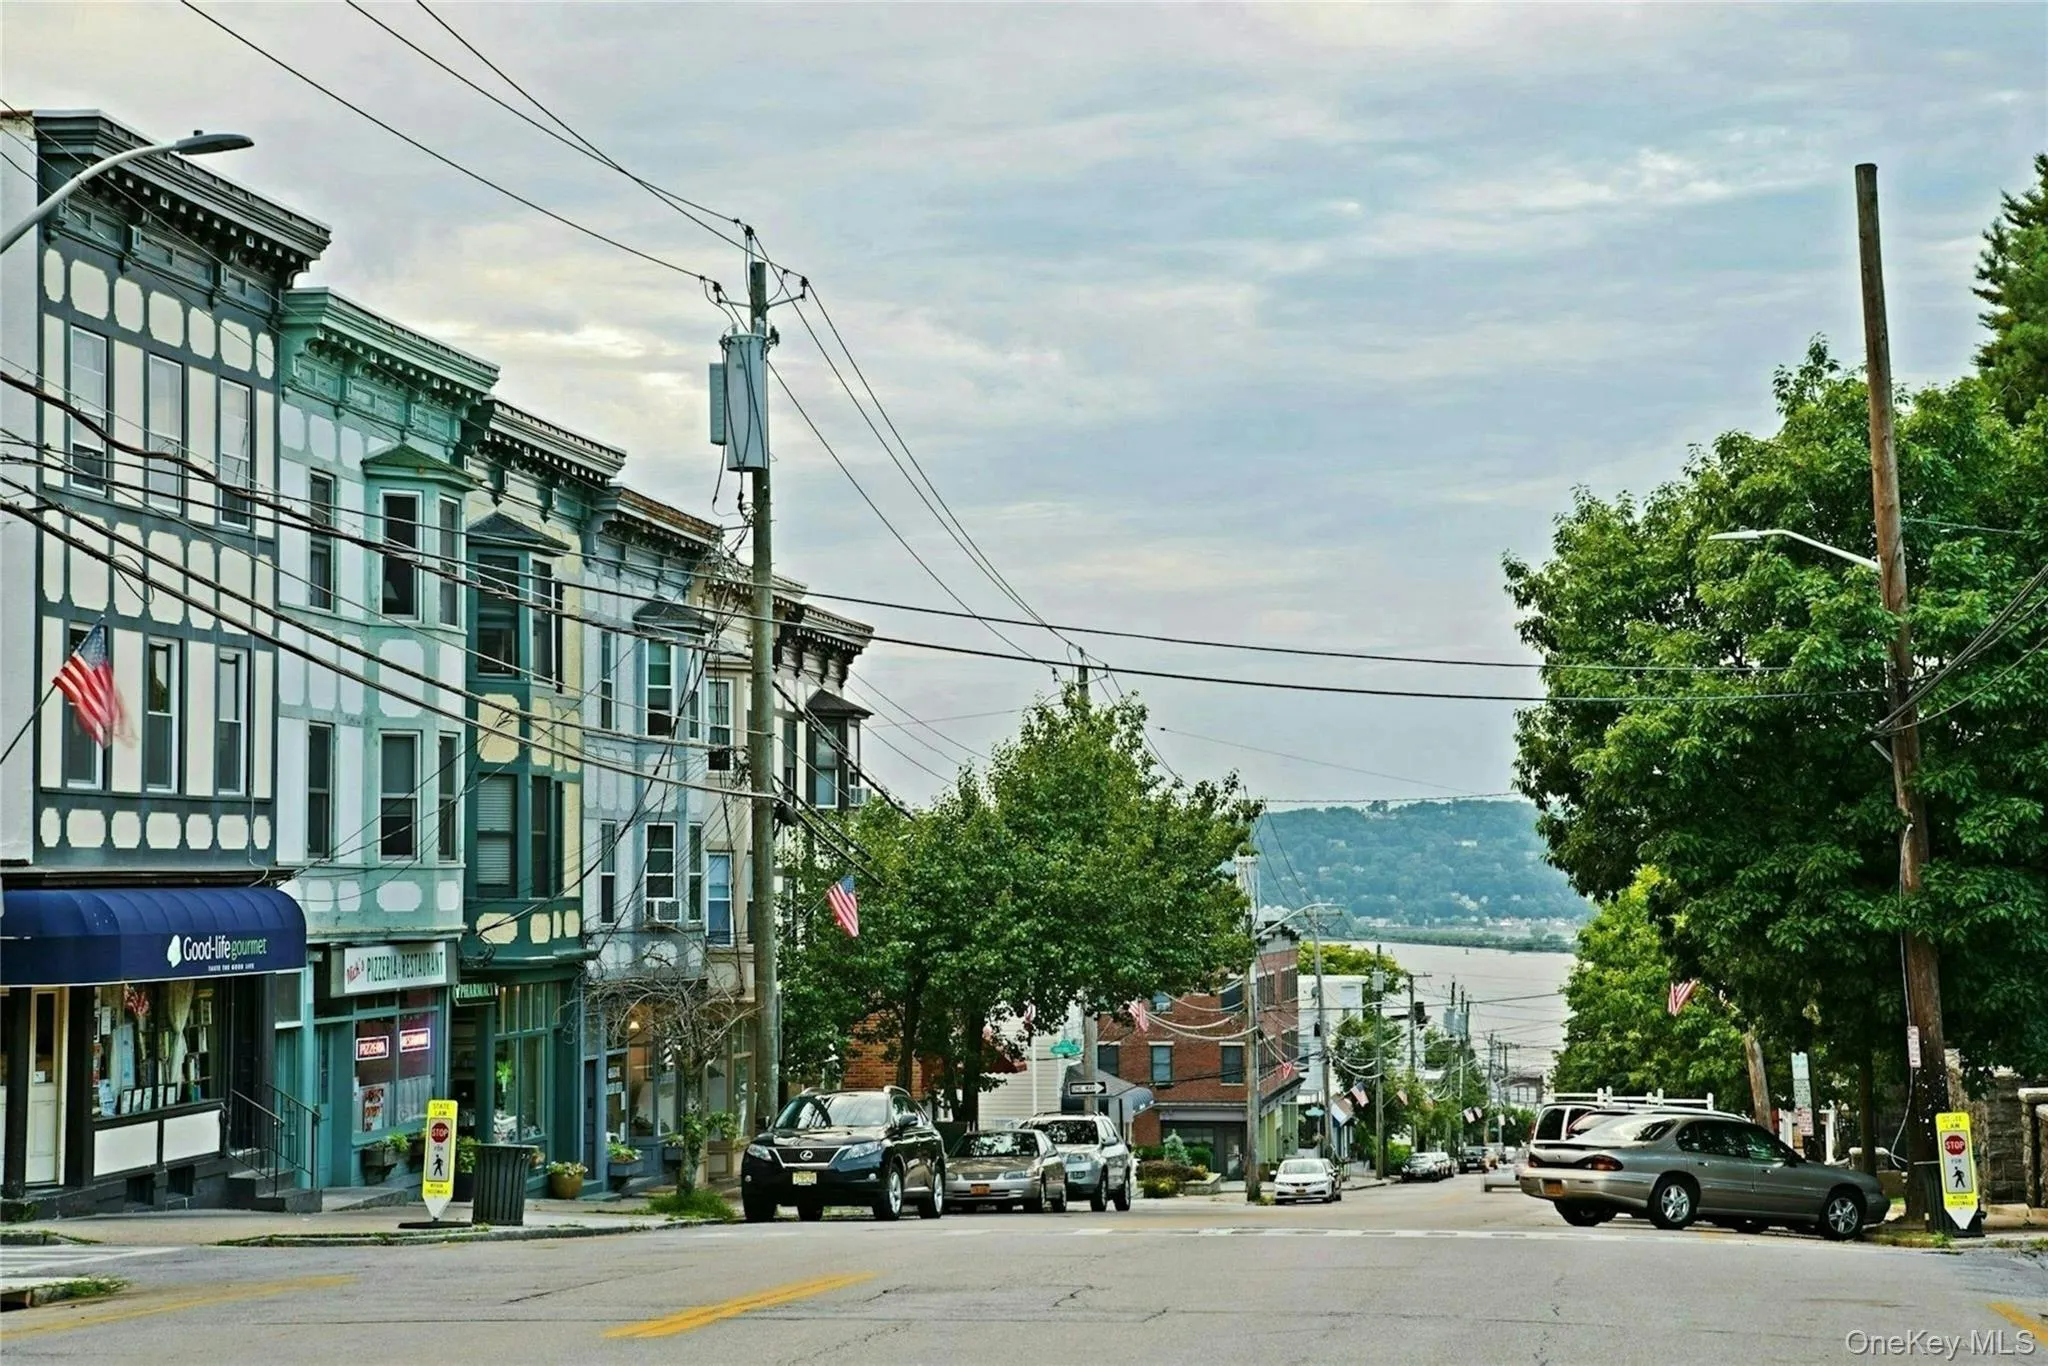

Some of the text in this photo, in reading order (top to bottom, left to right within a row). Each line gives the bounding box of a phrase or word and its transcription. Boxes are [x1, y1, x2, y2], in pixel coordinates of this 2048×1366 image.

[231, 938, 267, 960] gourmet
[367, 955, 398, 982] PIZZERIA
[401, 951, 443, 978] RESTAURANT
[460, 983, 494, 998] PHARMACY
[432, 1127, 449, 1137] STOP
[1945, 1140, 1965, 1150] STOP
